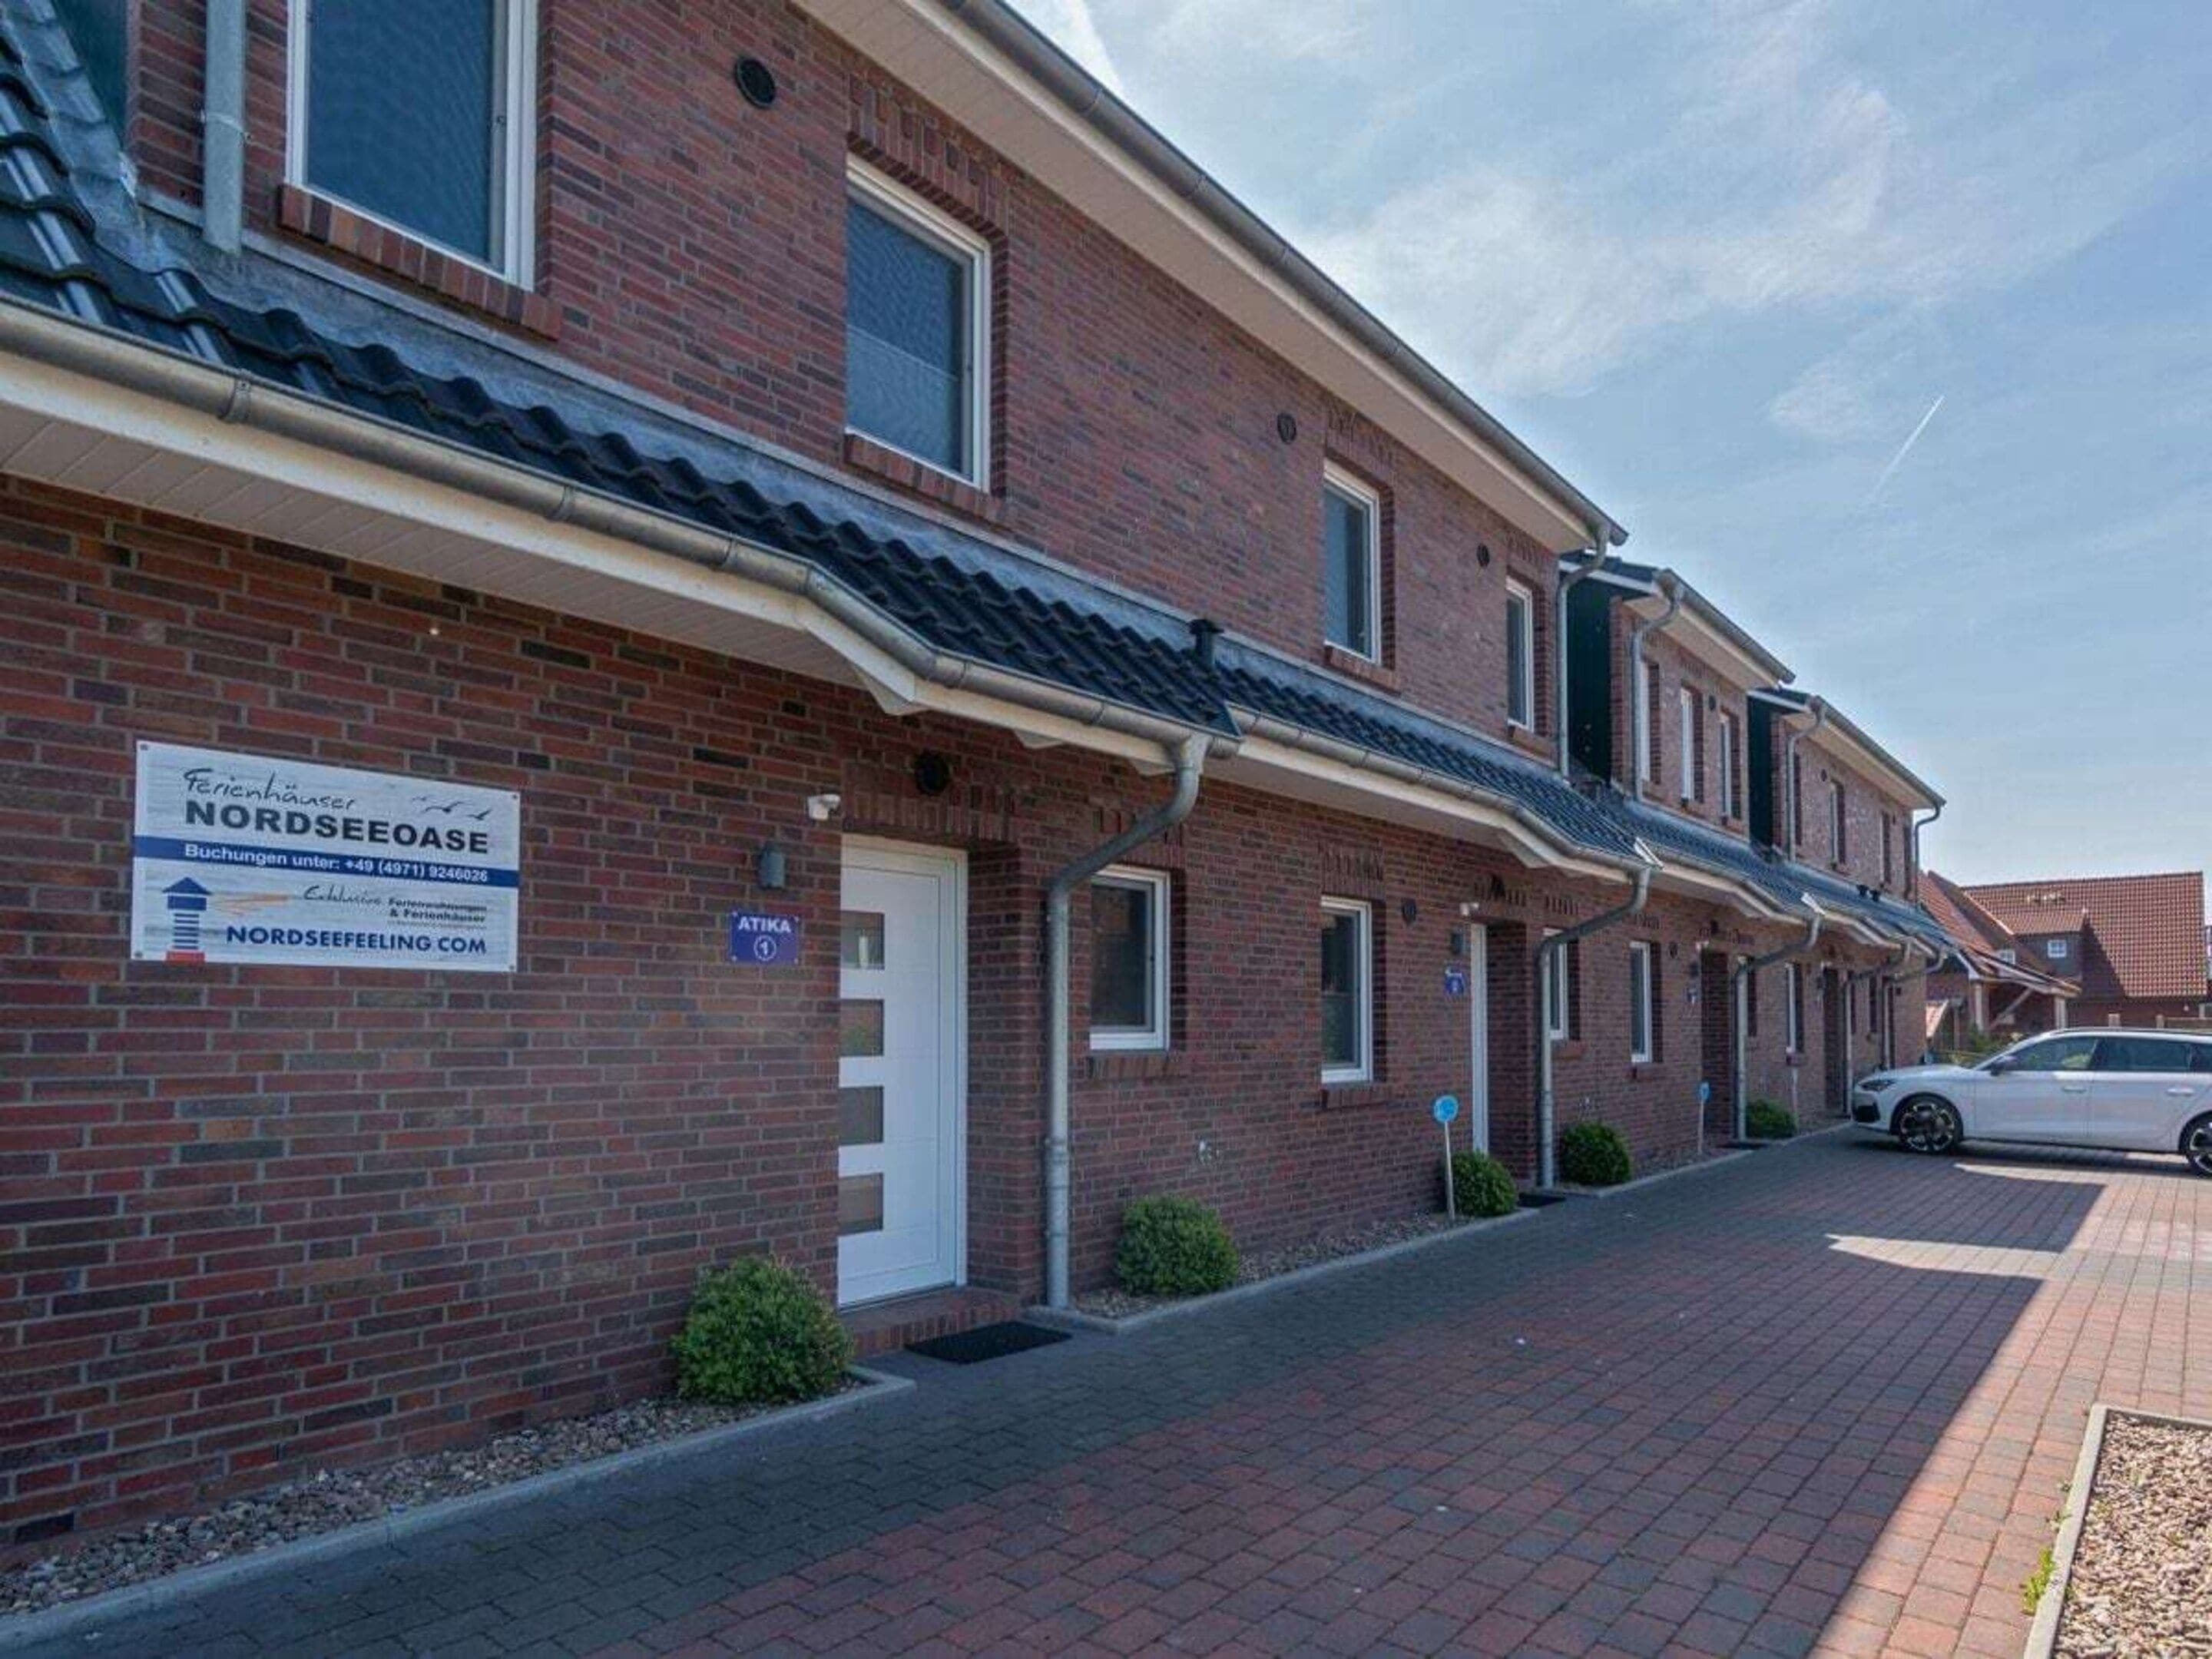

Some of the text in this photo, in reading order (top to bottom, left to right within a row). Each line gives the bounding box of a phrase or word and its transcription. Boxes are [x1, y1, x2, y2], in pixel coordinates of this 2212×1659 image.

[184, 768, 356, 810] Ferienhäuser
[185, 800, 488, 854] NORDSEEOASE
[184, 844, 488, 882] Buchungen unter: +49 (4971) 9246026
[738, 916, 792, 933] ATIKA
